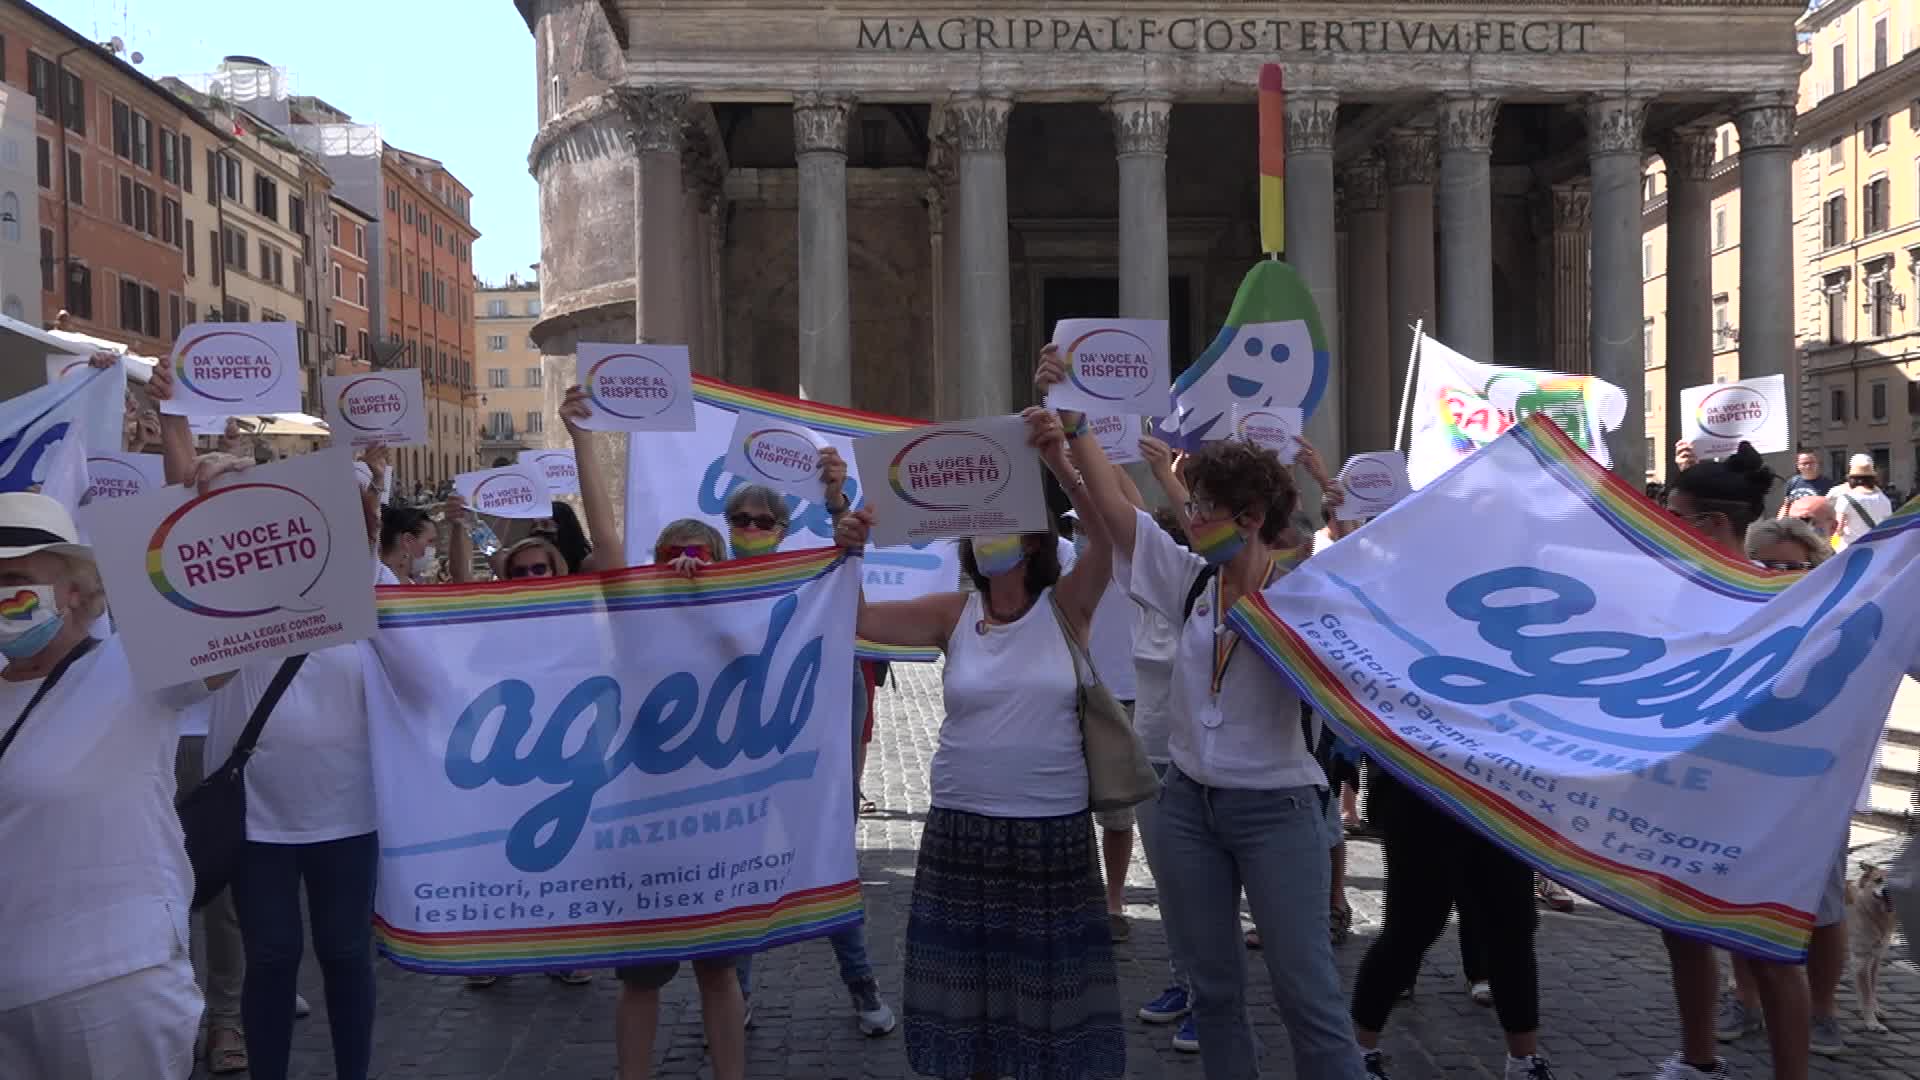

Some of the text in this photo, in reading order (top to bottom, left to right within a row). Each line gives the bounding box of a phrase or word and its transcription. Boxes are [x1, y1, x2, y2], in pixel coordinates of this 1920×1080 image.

[193, 355, 272, 367] DA' VOCE AL
[1100, 352, 1132, 364] VOCE
[1134, 353, 1148, 365] AL
[194, 367, 272, 380] RISPETTO
[1081, 364, 1149, 379] RISPETTO
[620, 375, 648, 386] VOCE
[652, 377, 666, 386] AL
[388, 393, 400, 402] AL
[600, 386, 669, 399] RISPETTO
[350, 402, 401, 417] RISPETTO
[1750, 401, 1761, 409] AL
[1707, 409, 1762, 425] RISPETTO
[755, 449, 812, 473] RISPETTO
[775, 446, 800, 458] VOCE
[802, 454, 813, 463] AL
[934, 456, 974, 470] VOCE
[979, 454, 996, 466] AL
[95, 477, 140, 488] VOCE AL
[910, 468, 999, 490] RISPETTO
[497, 488, 518, 497] VOCE
[520, 486, 532, 494] AL
[483, 493, 533, 509] RISPETTO
[177, 516, 313, 562] DA' VOCE AL
[184, 536, 317, 588] RISPETTO
[207, 614, 327, 650] SI ALLA LEGGE CONTRO
[190, 622, 344, 667] OMOTRANSFOBIA E MISOGINIA
[444, 594, 824, 873] agedo
[1319, 613, 1402, 689] Genitori,
[1483, 750, 1557, 794] amici
[1567, 790, 1600, 810] di
[1606, 806, 1743, 860] persone
[1487, 712, 1713, 792] NAZIONALE
[1463, 755, 1557, 814] bisex
[1570, 815, 1591, 833] e
[414, 879, 531, 900] Genitori,
[539, 871, 634, 898] parenti,
[640, 864, 701, 887] amici
[708, 861, 726, 881] di
[414, 901, 555, 923] lesbiche,
[567, 900, 624, 919] gay,
[637, 891, 704, 910] bisex
[714, 888, 725, 902] e
